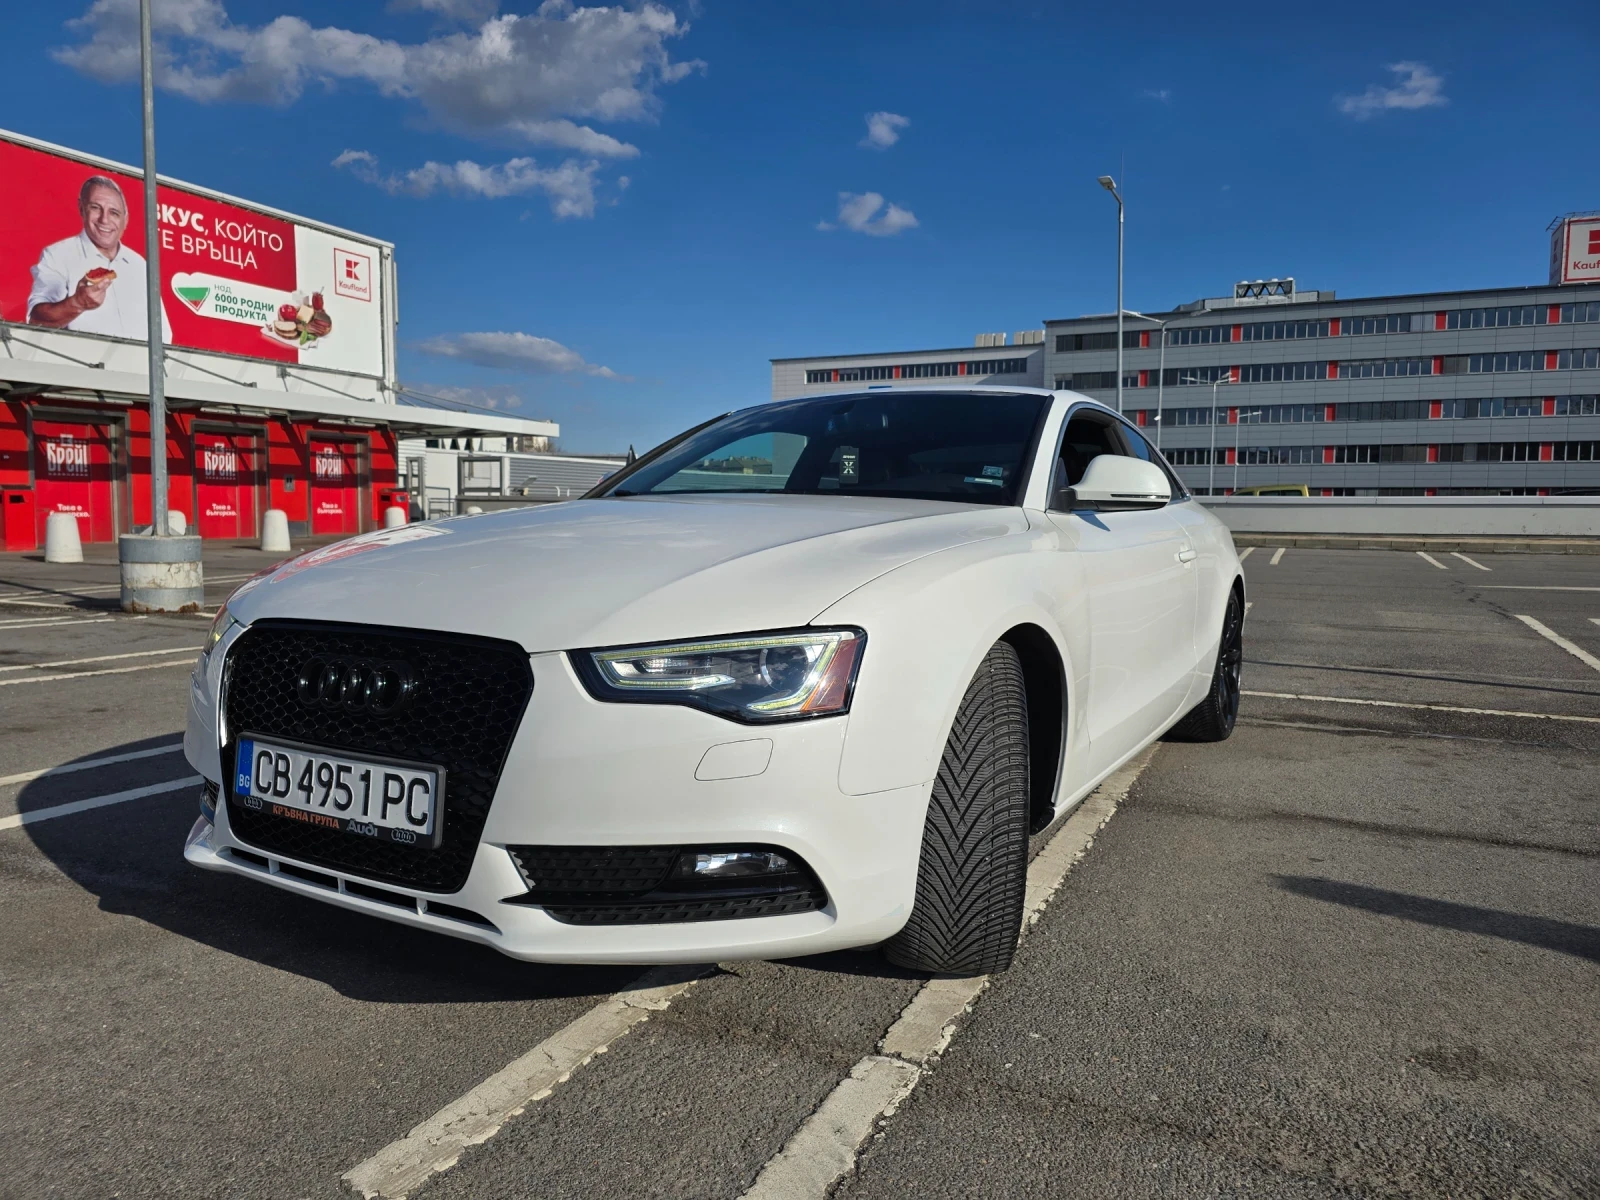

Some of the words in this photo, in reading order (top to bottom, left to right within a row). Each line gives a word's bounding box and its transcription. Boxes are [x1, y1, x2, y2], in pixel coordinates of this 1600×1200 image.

[215, 217, 284, 252] КОЙТО
[157, 227, 175, 250] Е
[181, 233, 258, 270] ВРЪЩА
[338, 280, 368, 294] Kaufland
[214, 292, 238, 305] 6000
[240, 297, 275, 313] РОДНИ
[214, 303, 268, 322] ПРОДУКТА
[238, 773, 250, 788] BG
[255, 750, 293, 798] CB
[298, 758, 374, 818] 4951
[380, 772, 431, 827] PC
[272, 804, 309, 823] КРЪВНА
[309, 813, 340, 830] ГРУПА
[346, 818, 378, 837] Audi
